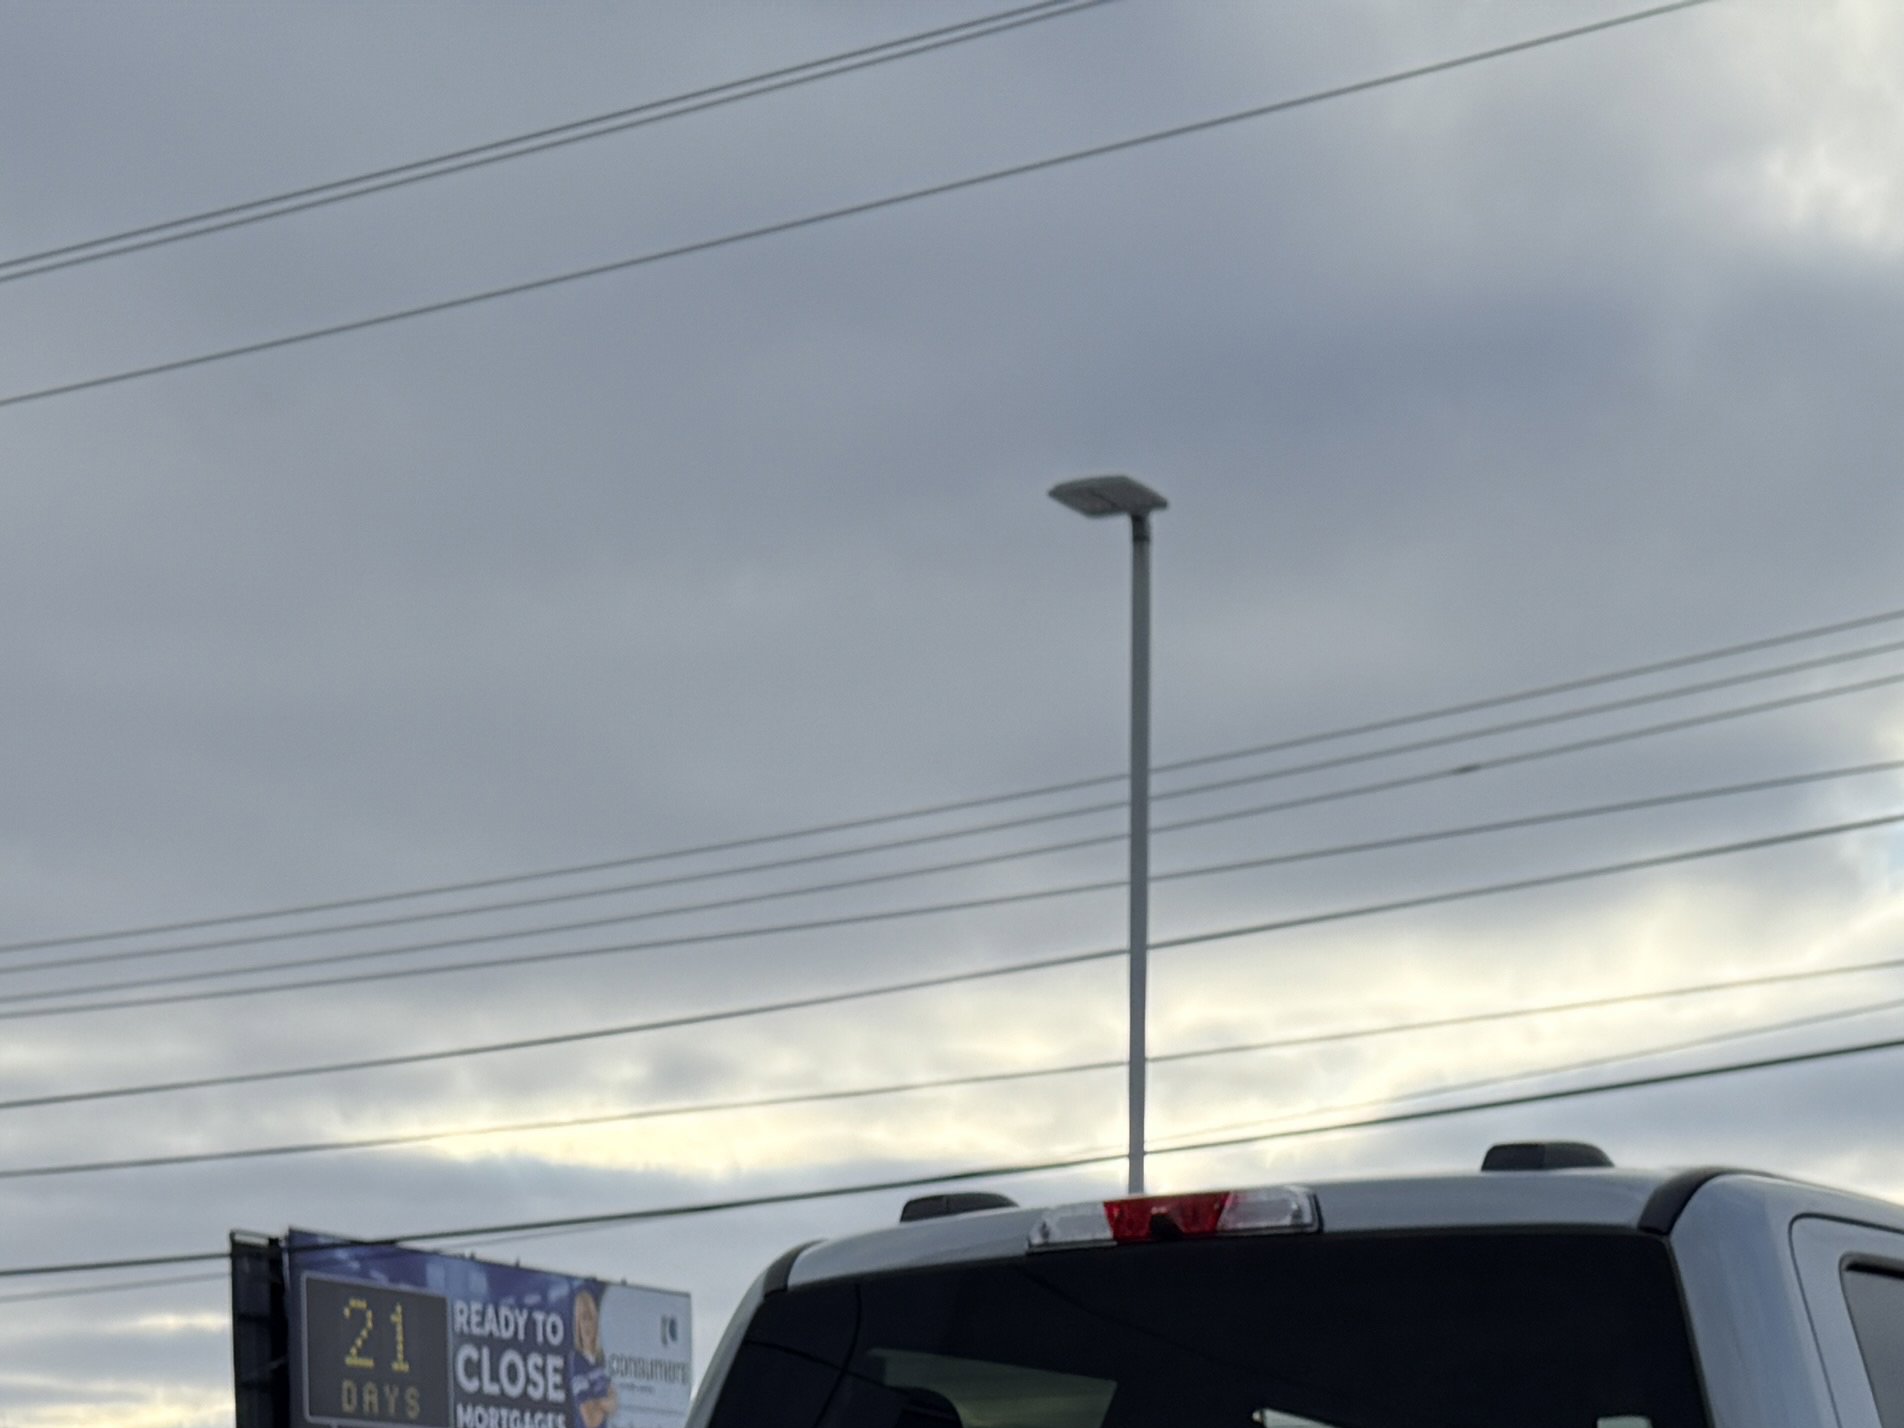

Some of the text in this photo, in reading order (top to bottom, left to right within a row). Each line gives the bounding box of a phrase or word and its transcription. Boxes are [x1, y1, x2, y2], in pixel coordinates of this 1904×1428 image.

[343, 1299, 409, 1372] 21
[455, 1299, 564, 1346] READY TO
[342, 1380, 421, 1419] DAYS
[457, 1344, 565, 1403] CLOSE
